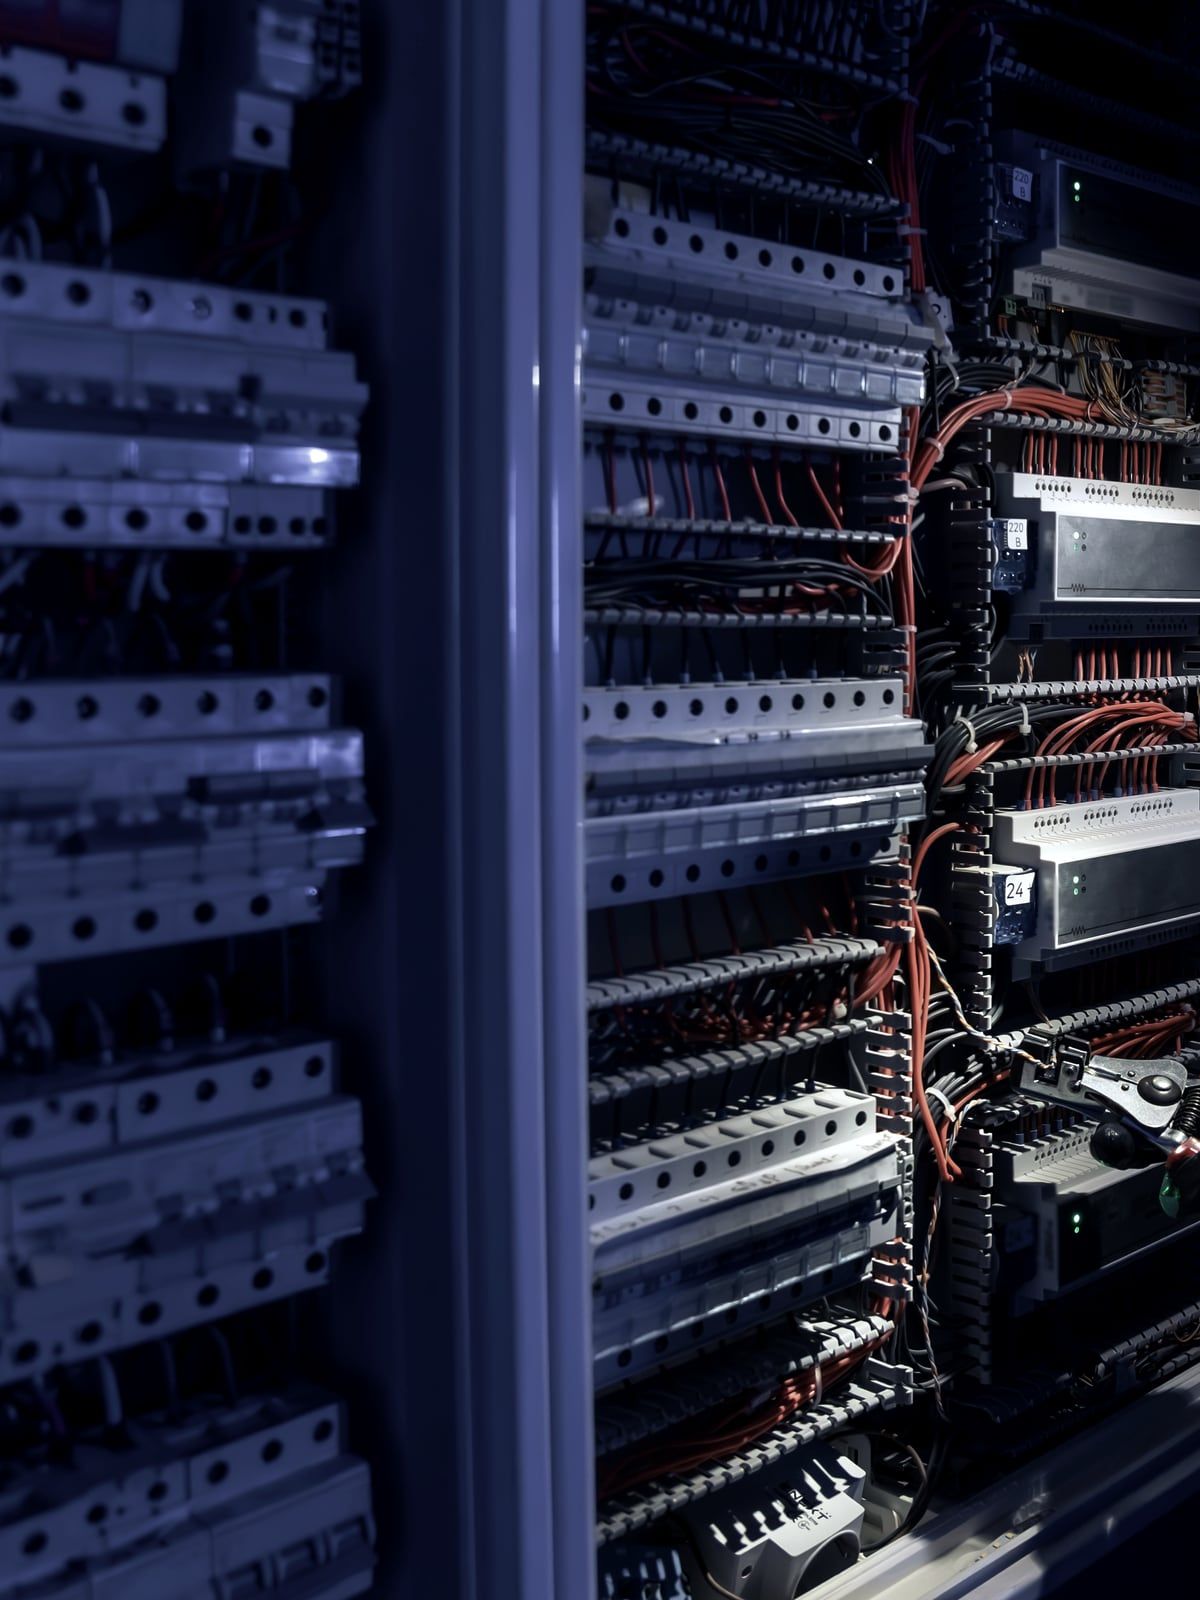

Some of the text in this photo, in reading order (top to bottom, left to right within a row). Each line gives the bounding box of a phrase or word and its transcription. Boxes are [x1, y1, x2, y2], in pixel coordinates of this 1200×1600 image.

[1008, 522, 1024, 533] 220
[1015, 536, 1022, 548] B
[1006, 882, 1023, 900] 24
